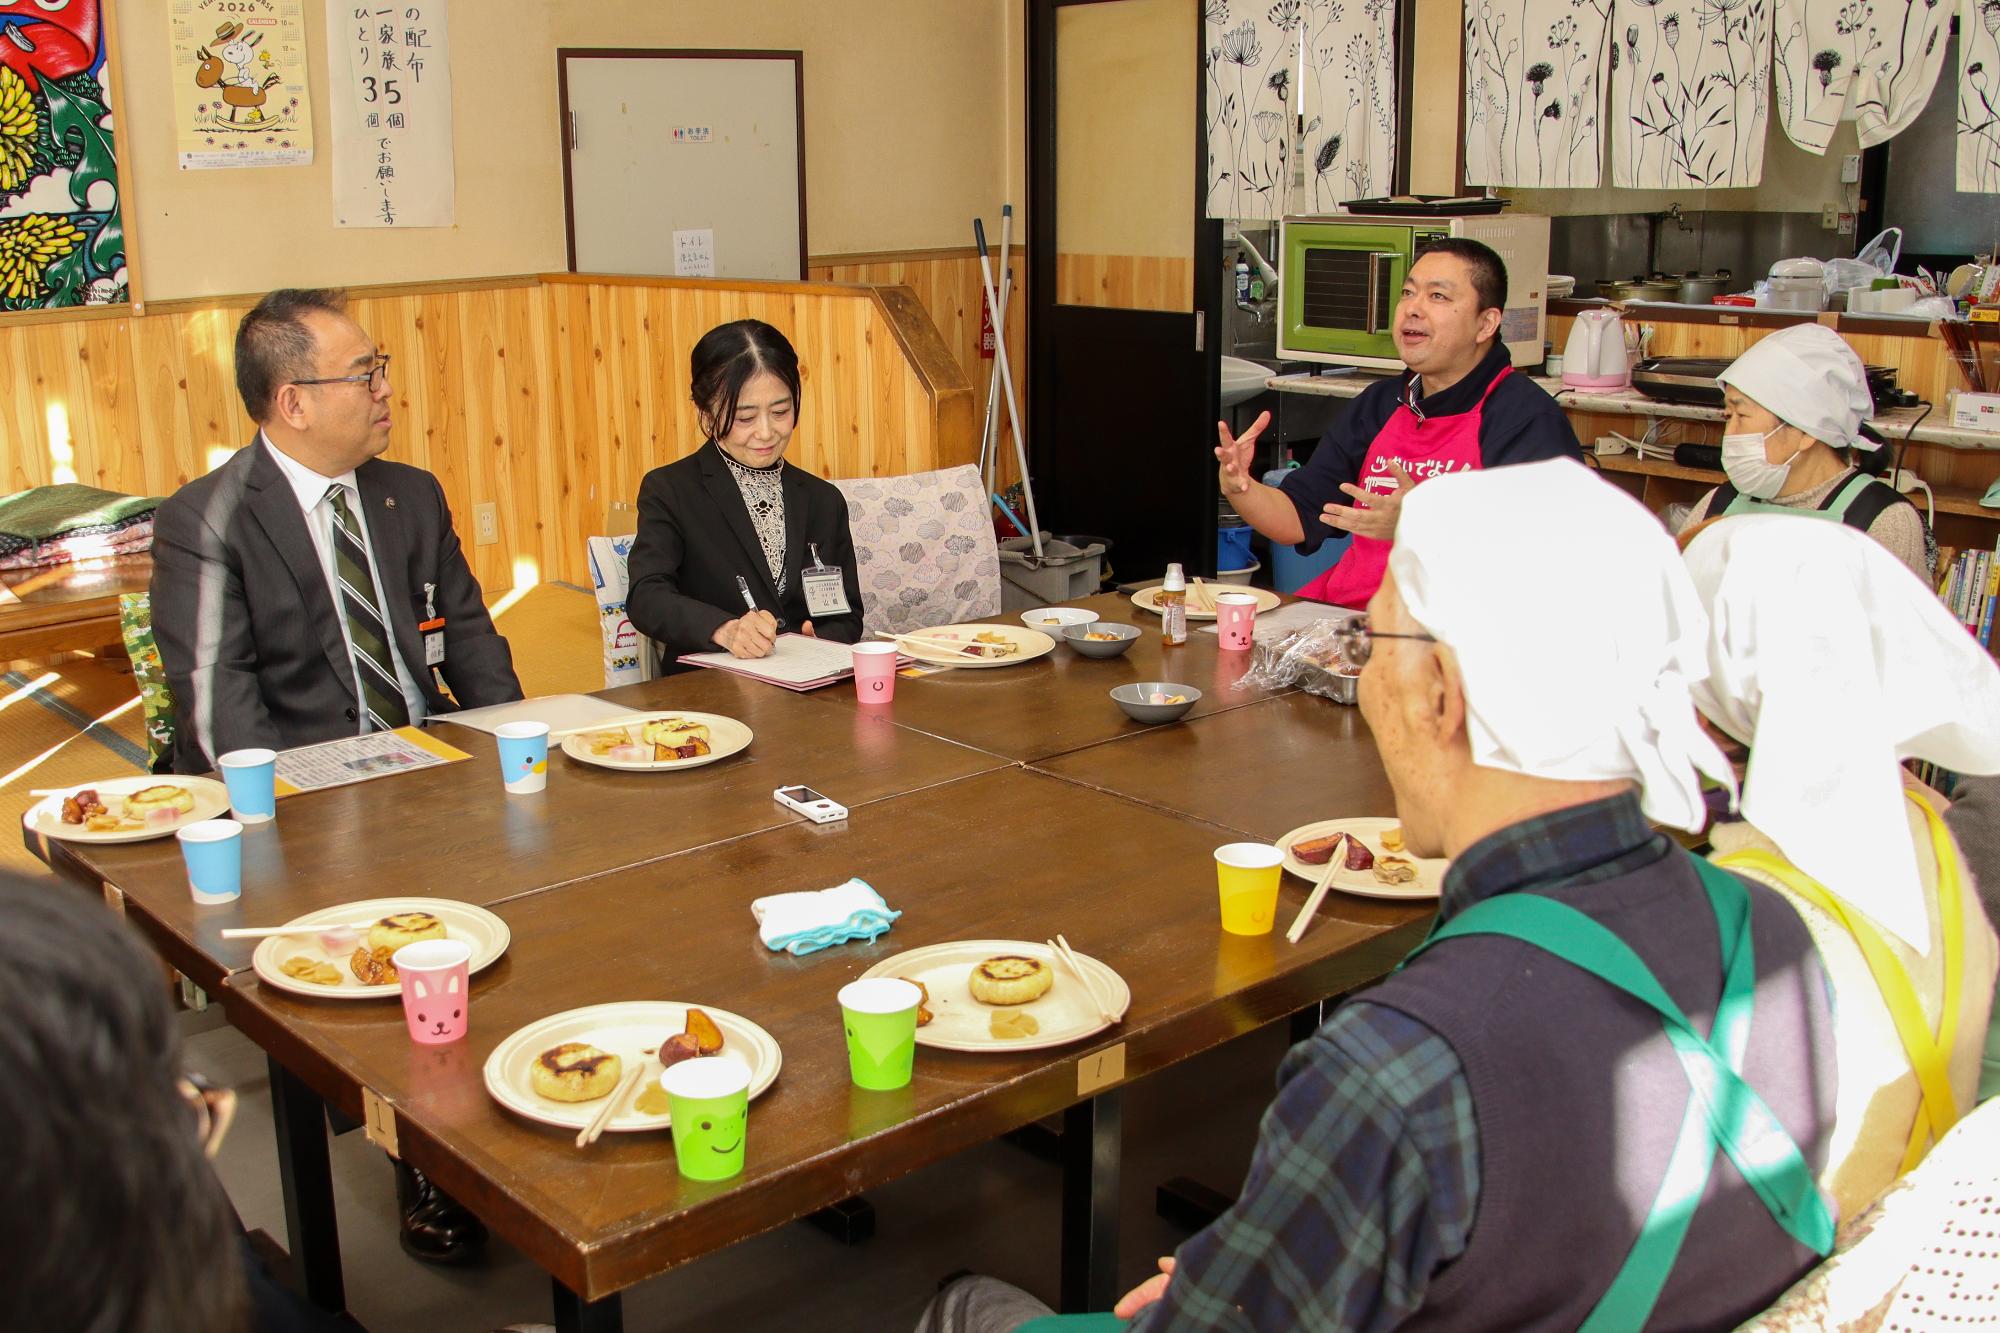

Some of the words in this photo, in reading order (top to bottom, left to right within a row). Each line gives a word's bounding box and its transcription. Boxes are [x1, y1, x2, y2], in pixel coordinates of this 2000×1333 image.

[218, 2, 255, 12] 2026
[405, 8, 432, 83] の配布
[354, 8, 380, 128] ひとり3個
[376, 9, 405, 128] 一家族5個
[375, 137, 396, 225] でお願いします
[680, 236, 703, 249] トイレ
